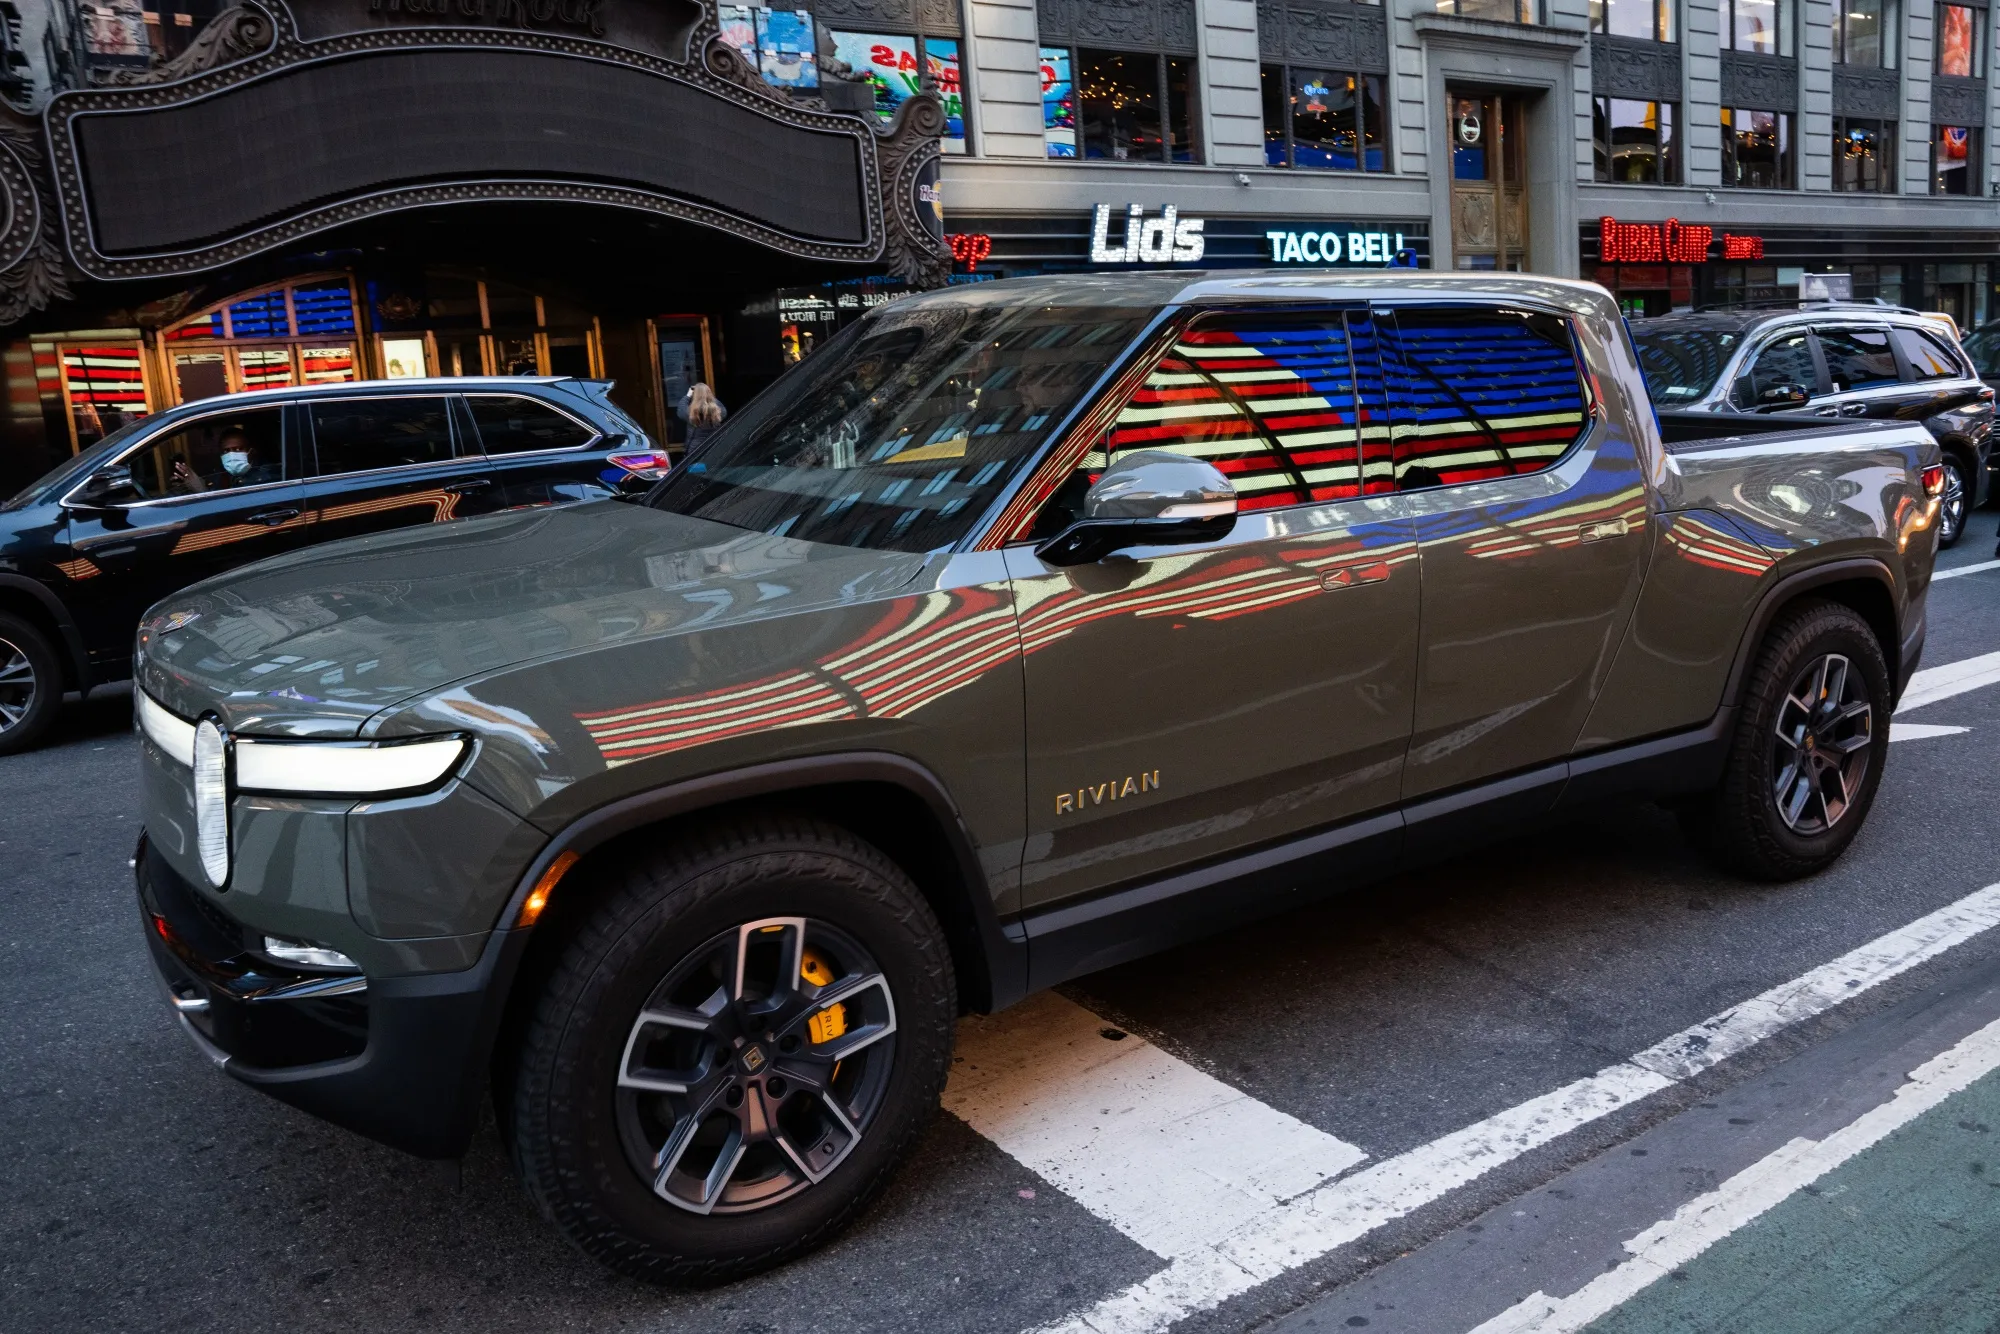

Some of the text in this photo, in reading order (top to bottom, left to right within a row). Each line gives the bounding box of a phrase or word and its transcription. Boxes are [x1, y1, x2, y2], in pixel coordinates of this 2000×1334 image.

[1090, 202, 1206, 263] Lids
[1265, 230, 1342, 263] TACO
[1056, 769, 1161, 815] RIVIAN
